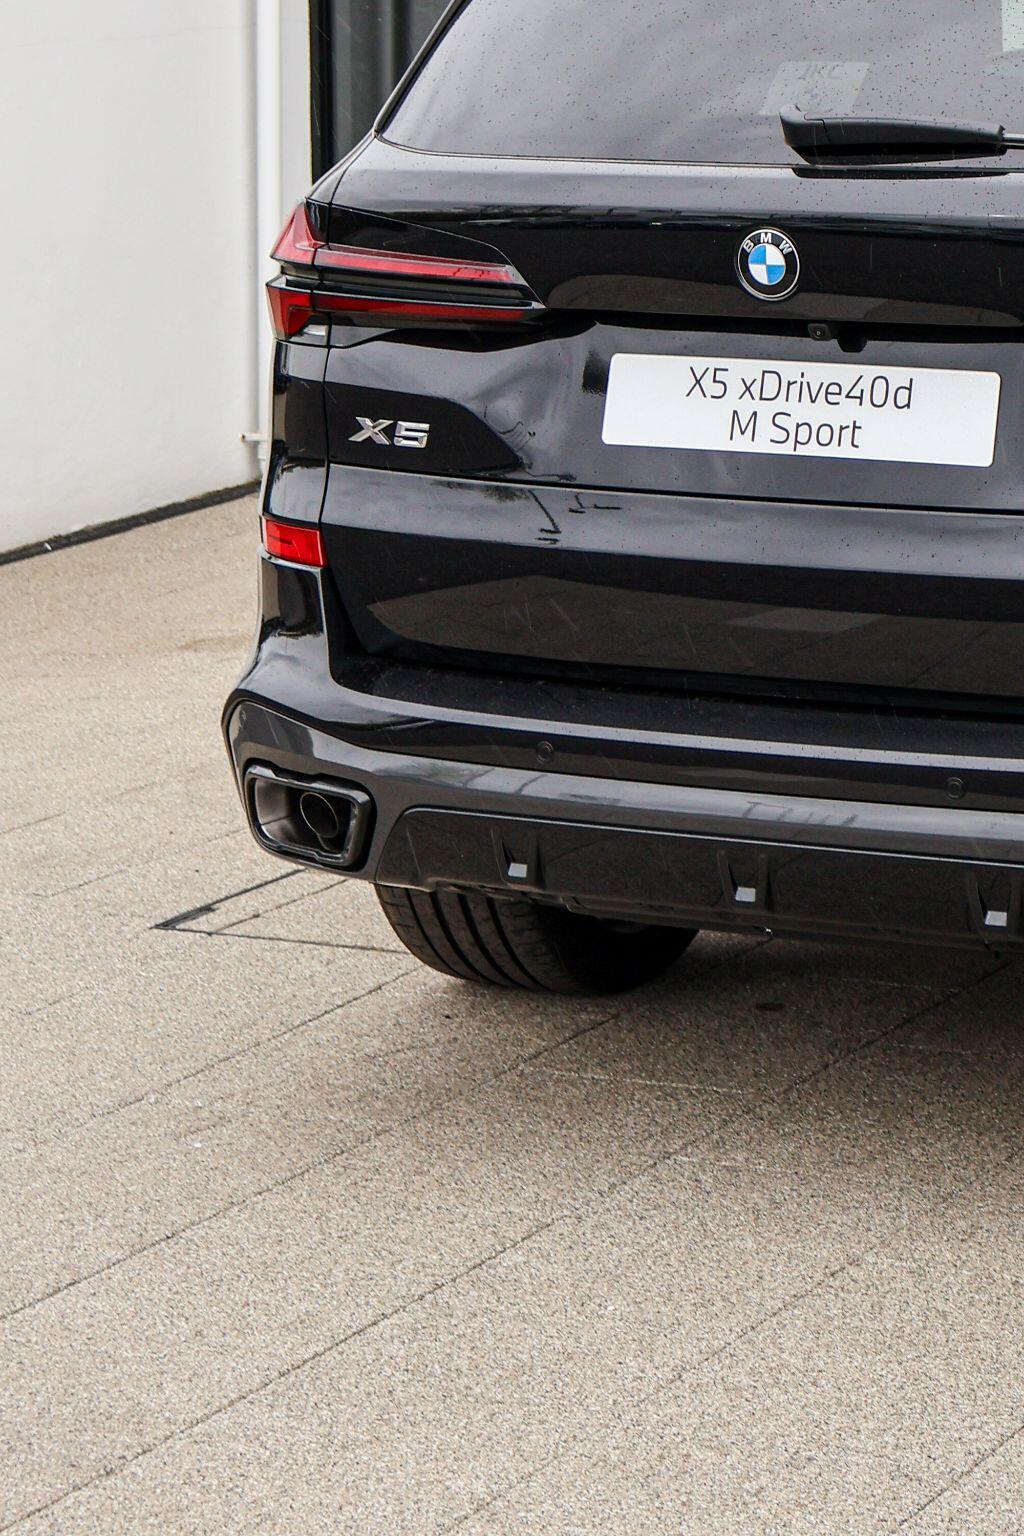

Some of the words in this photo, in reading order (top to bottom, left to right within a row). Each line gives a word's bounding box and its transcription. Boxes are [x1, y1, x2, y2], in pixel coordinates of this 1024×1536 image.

[742, 232, 793, 254] BMW
[685, 366, 729, 400] X5
[738, 370, 914, 410] xDrive40d
[347, 416, 430, 449] X5
[729, 409, 758, 443] M
[769, 412, 863, 452] Sport
